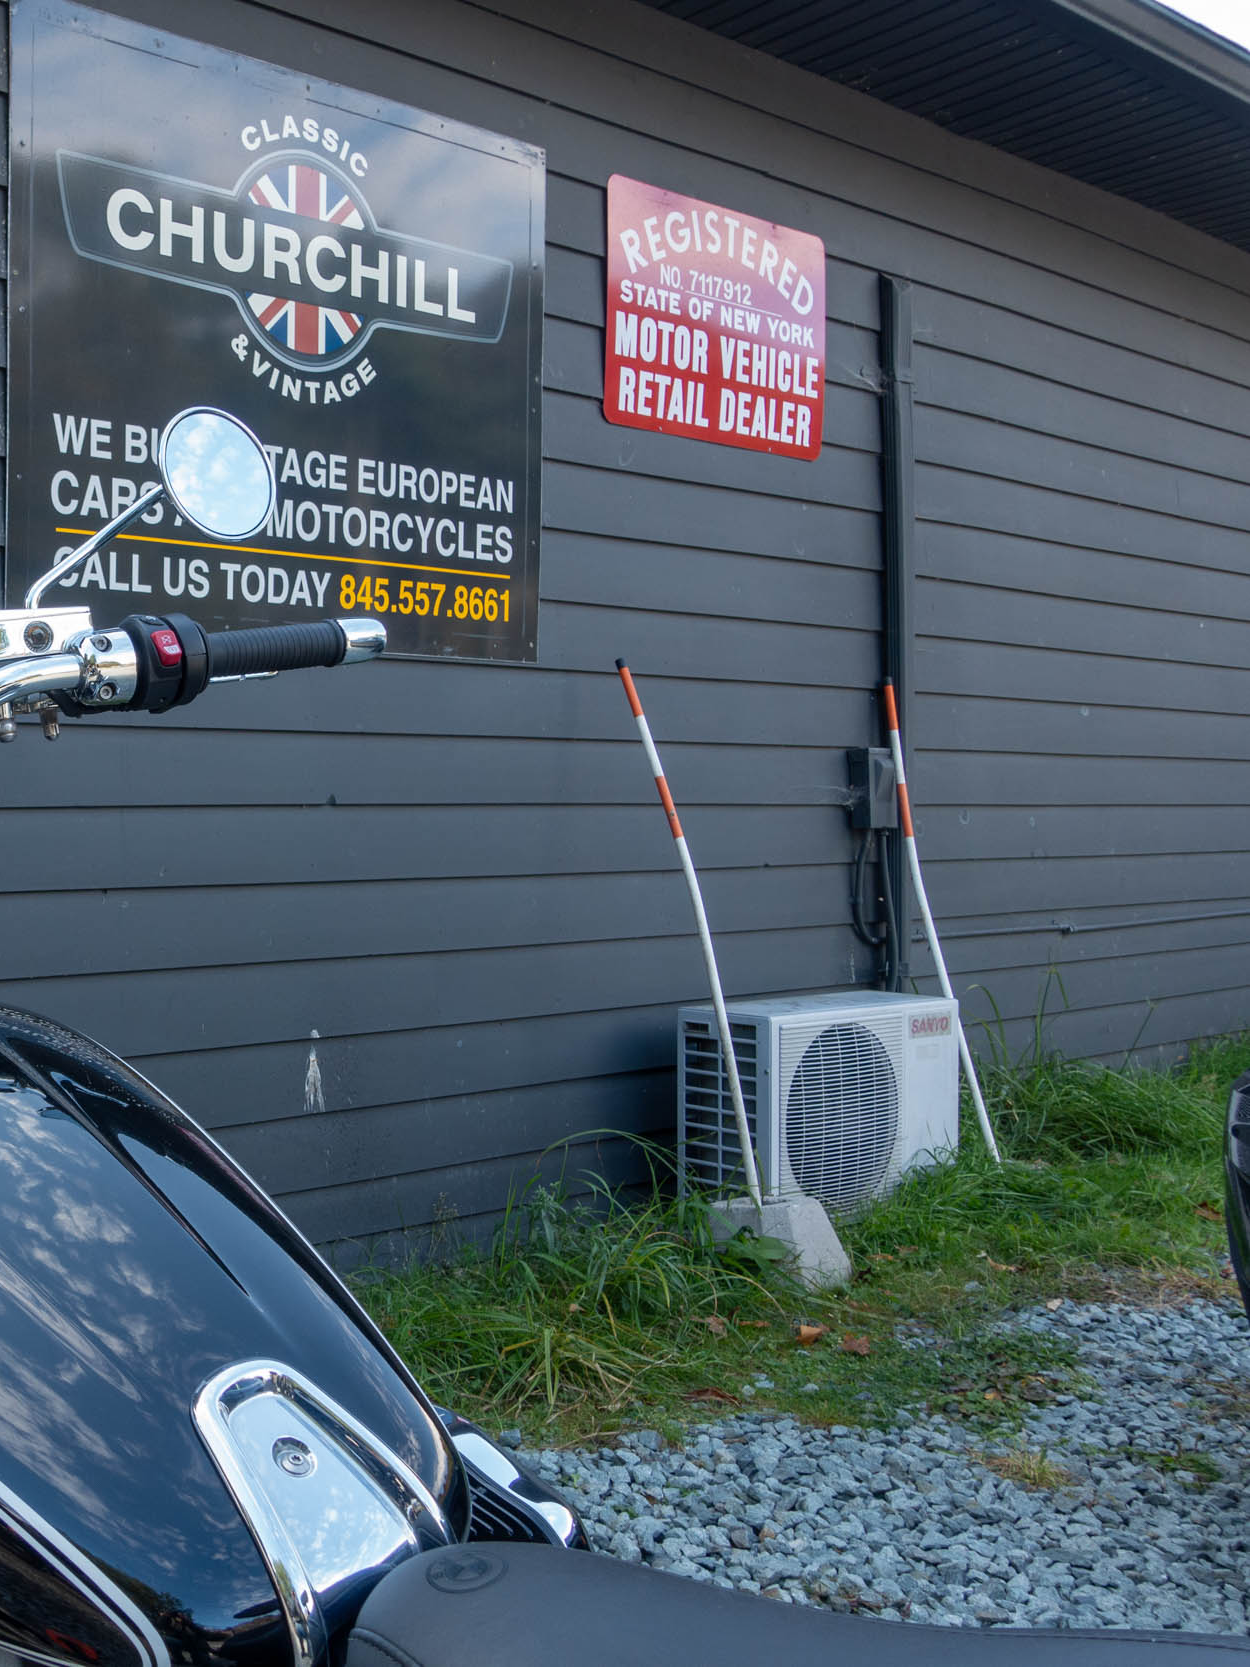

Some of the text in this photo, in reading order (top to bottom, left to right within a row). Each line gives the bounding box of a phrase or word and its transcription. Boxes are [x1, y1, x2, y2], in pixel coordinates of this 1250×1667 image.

[241, 115, 368, 177] CLASSIC
[106, 188, 476, 324] CHURCHILL
[619, 209, 814, 316] REGISTERED
[660, 263, 752, 306] NO. 7117912
[619, 279, 815, 349] STATE OF NEW YORK
[231, 333, 378, 404] & VINTAGE
[614, 310, 819, 400] MOTOR VEHICLE
[618, 366, 812, 448] RETAIL DEALER
[52, 413, 112, 460] WE
[263, 444, 348, 491] TAGE
[357, 458, 514, 514] EUROPEAN
[51, 470, 513, 564] CARS MOTORCYCLES
[163, 557, 210, 598] US
[220, 562, 331, 608] TODAY
[339, 574, 511, 623] 845.557.8661
[911, 1015, 949, 1034] SANYO
